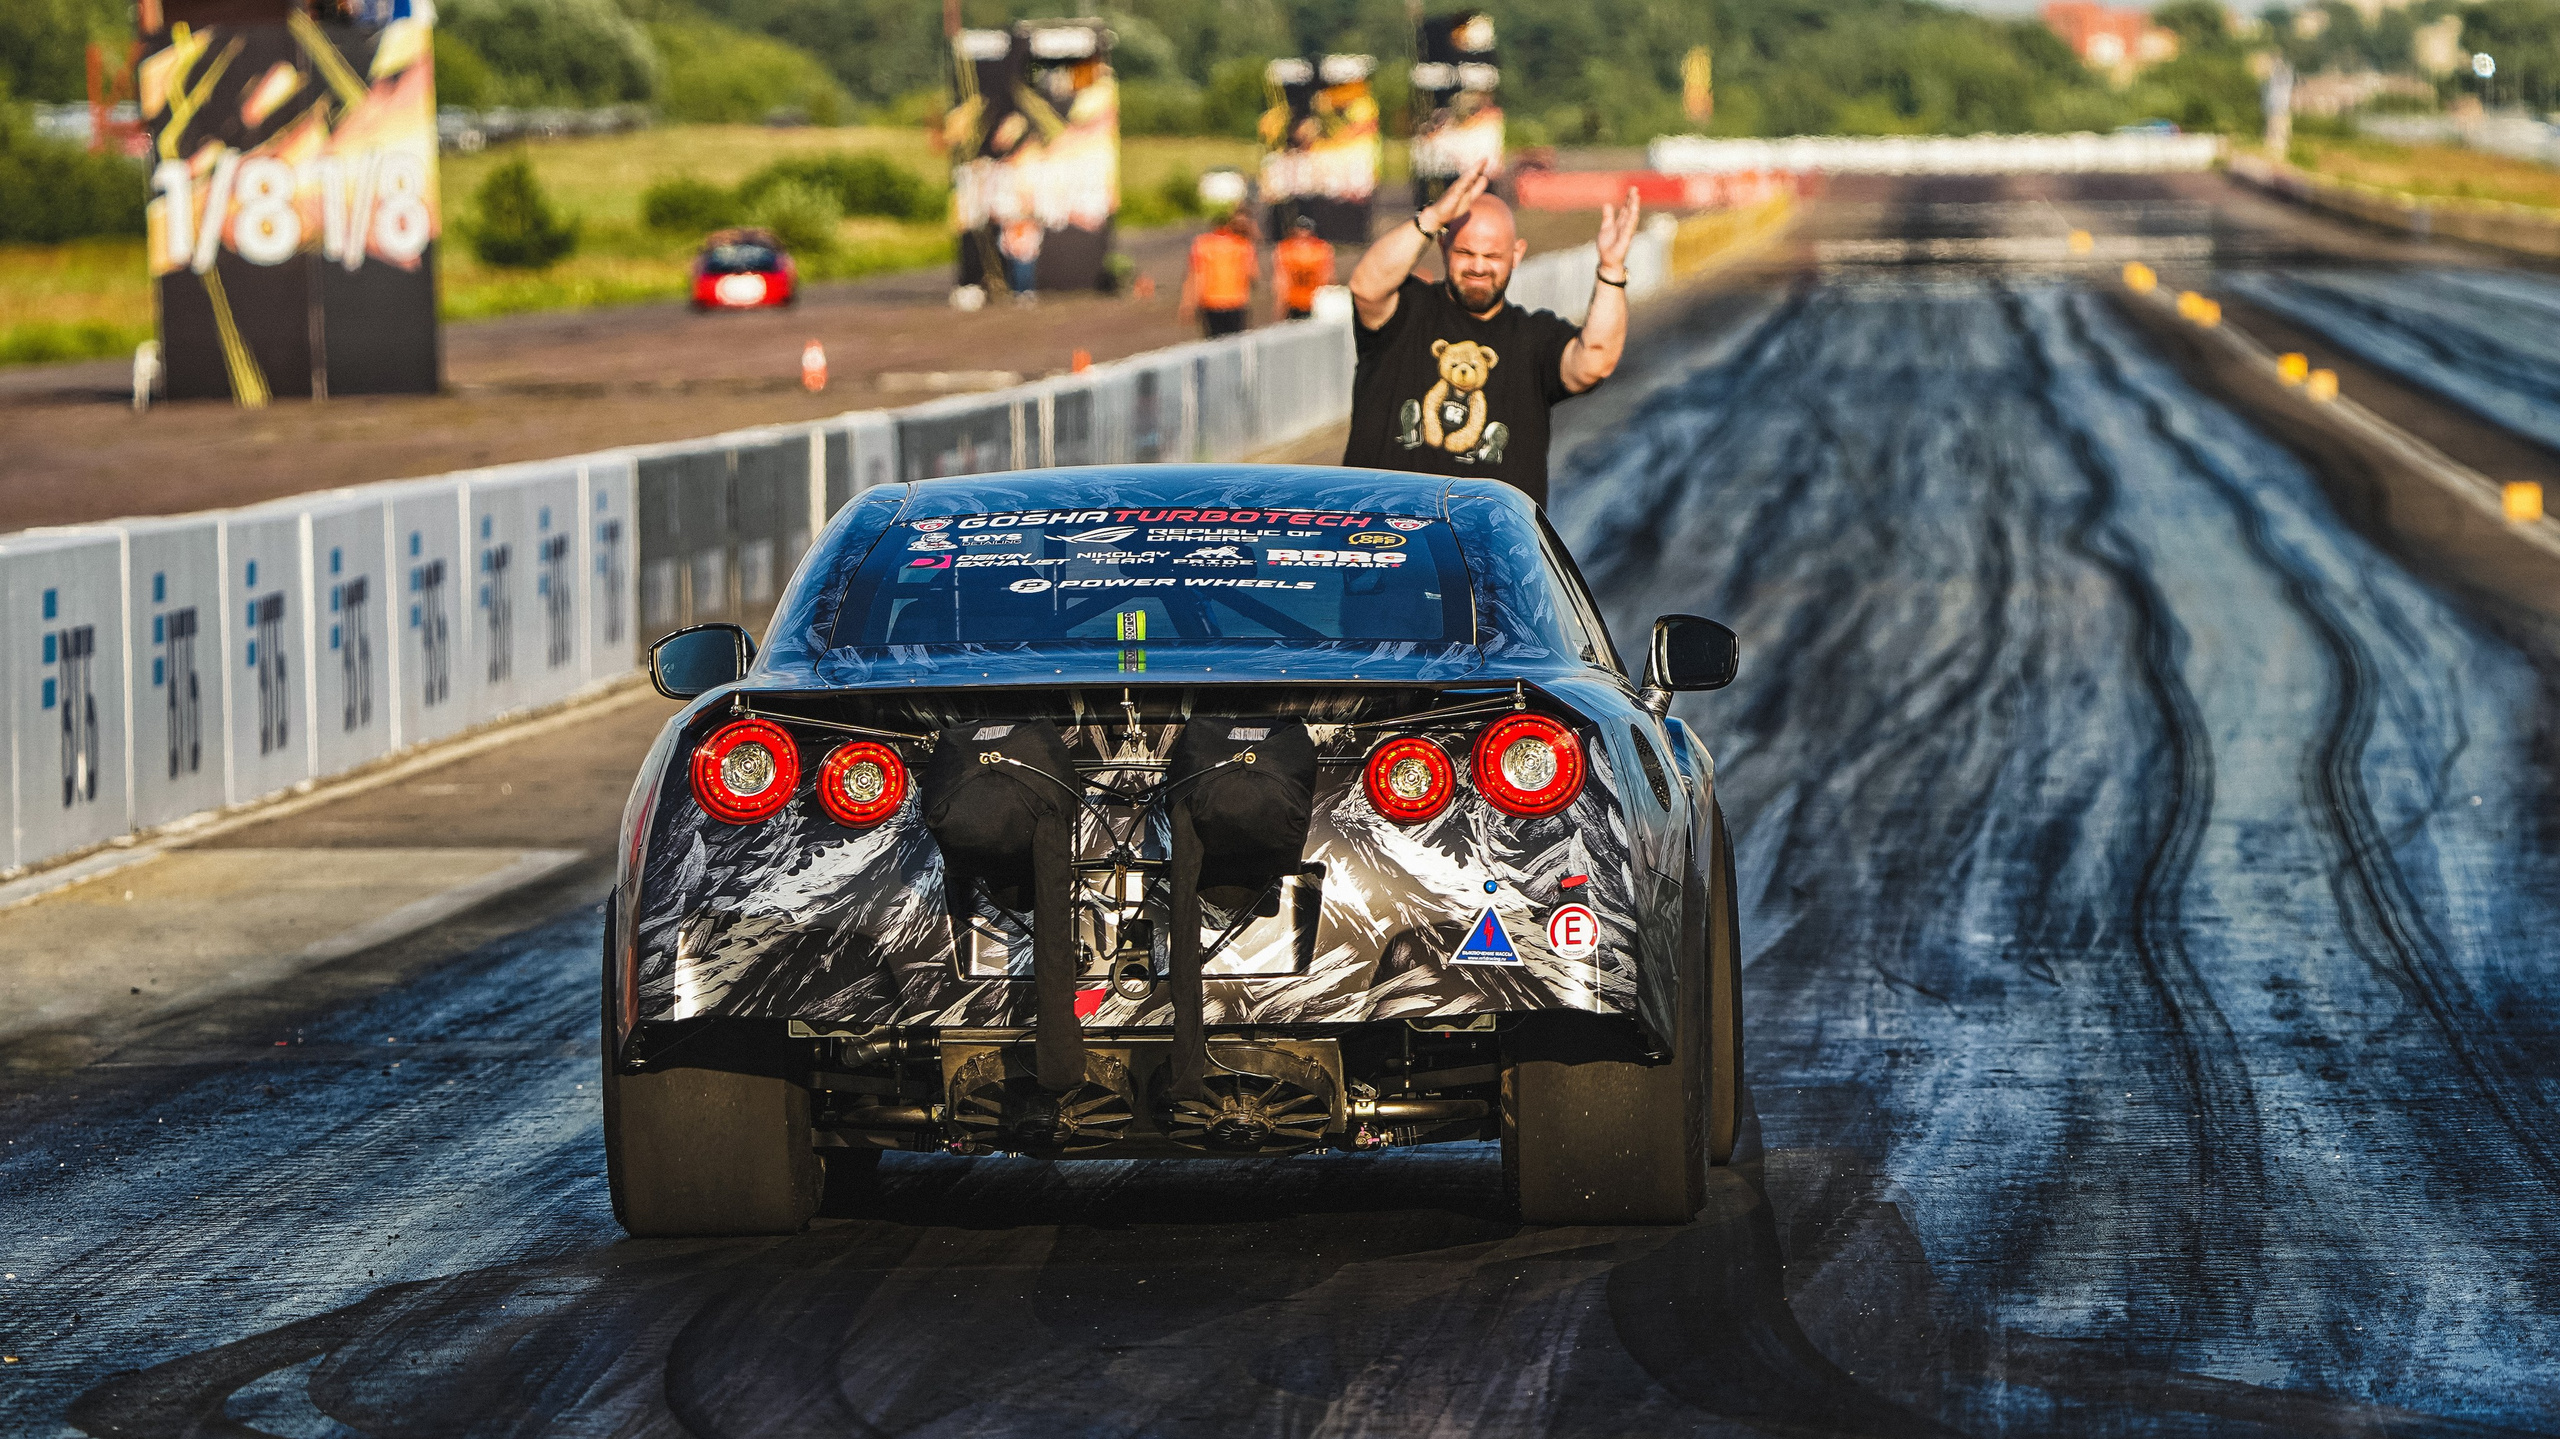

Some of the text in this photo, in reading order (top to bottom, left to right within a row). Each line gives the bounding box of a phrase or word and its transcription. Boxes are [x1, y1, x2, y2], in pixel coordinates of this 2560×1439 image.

[152, 148, 301, 276] 1/8
[1148, 528, 1281, 537] REPUBLIC
[958, 533, 1022, 542] TOYS
[1146, 535, 1259, 543] GAMERS
[955, 552, 1033, 561] DEIKIN
[1076, 551, 1170, 559] NIKOLAY
[1265, 548, 1407, 563] RDRC
[954, 558, 1072, 568] EXHAUST
[1172, 558, 1254, 566] PRIDE
[1279, 560, 1389, 568] RACEPARK
[1057, 578, 1317, 590] POWER WHEELS
[1565, 916, 1582, 945] E
